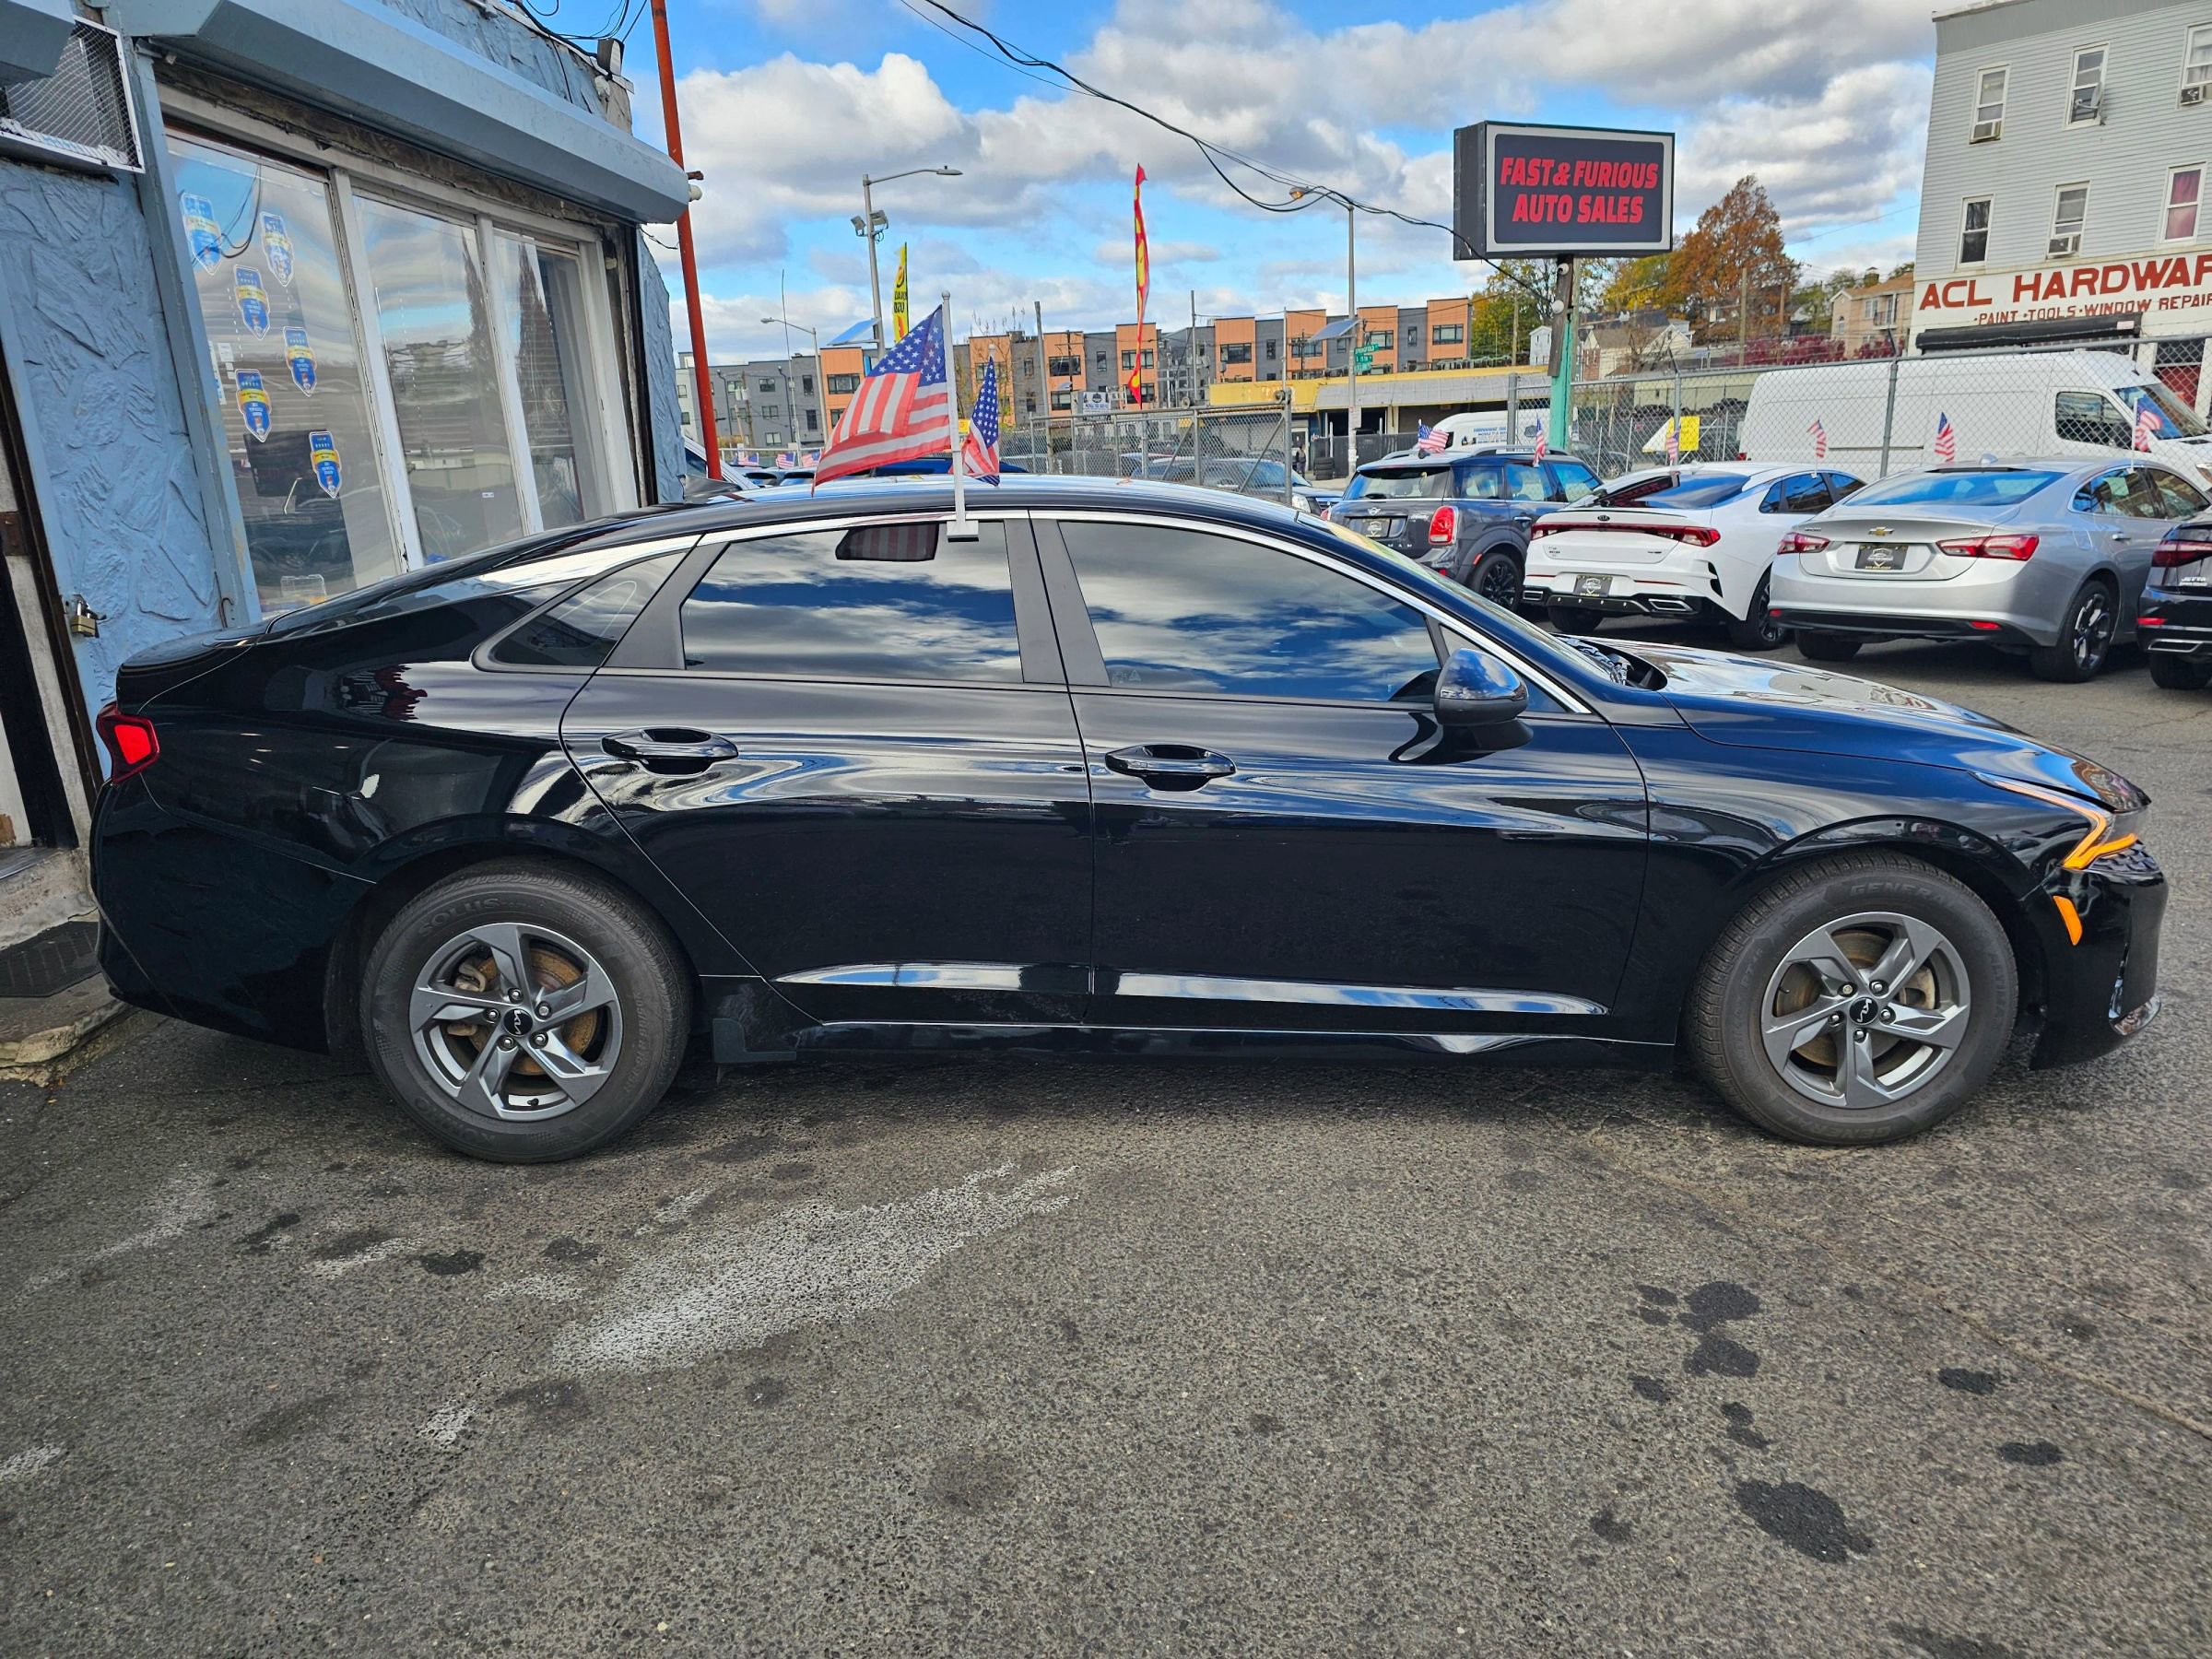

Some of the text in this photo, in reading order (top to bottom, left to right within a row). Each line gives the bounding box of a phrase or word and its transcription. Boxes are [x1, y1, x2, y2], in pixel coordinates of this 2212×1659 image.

[1500, 158, 1659, 189] FAST & FURIOUS
[1512, 194, 1643, 224] AUTO SALES
[1919, 279, 1993, 311] ACL
[1979, 311, 2018, 324] PAINT
[2029, 306, 2077, 321] TOOLS
[2085, 299, 2152, 316] WINDOW
[419, 898, 500, 936] SOLUS
